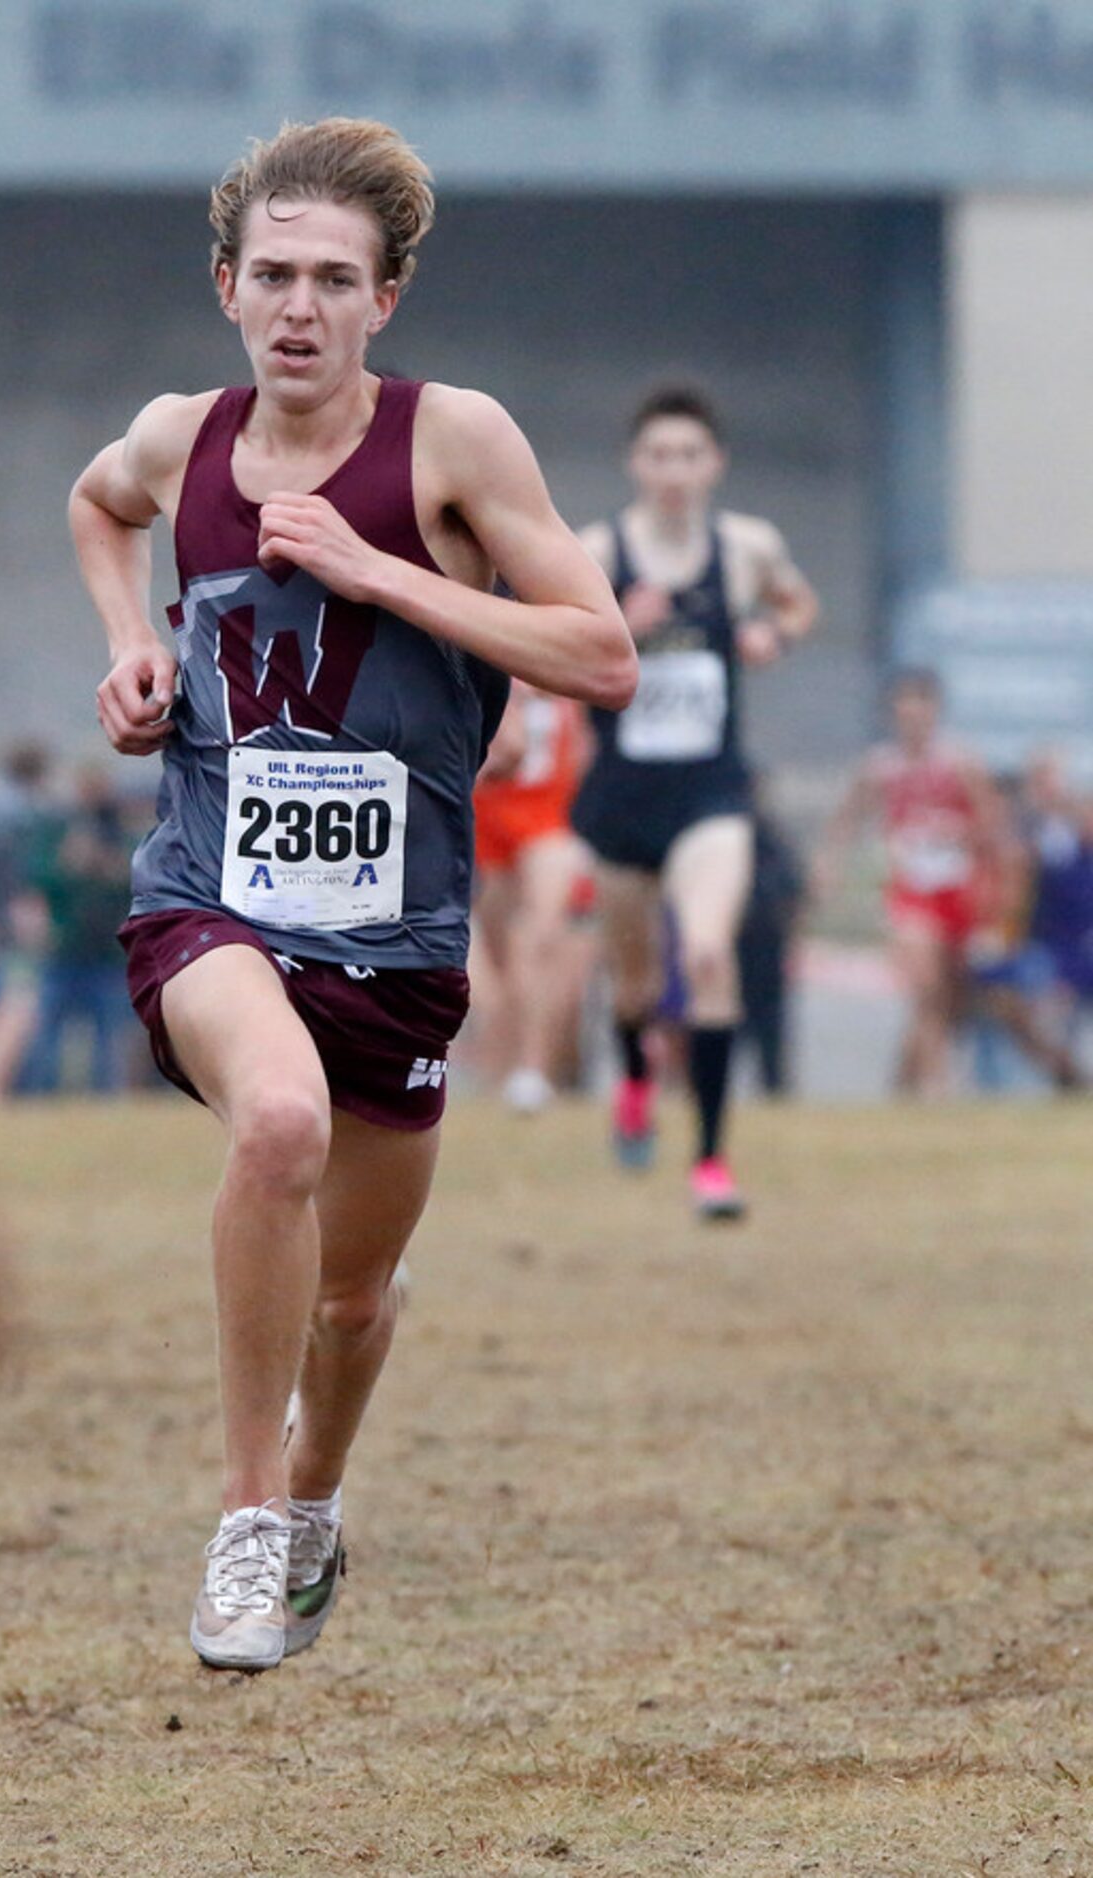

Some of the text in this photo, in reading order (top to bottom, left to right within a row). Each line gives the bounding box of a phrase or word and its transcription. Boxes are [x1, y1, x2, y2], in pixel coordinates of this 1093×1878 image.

[267, 761, 291, 774] UIL
[295, 763, 349, 777] Region
[246, 774, 387, 792] XC Championships
[237, 796, 392, 863] 2360
